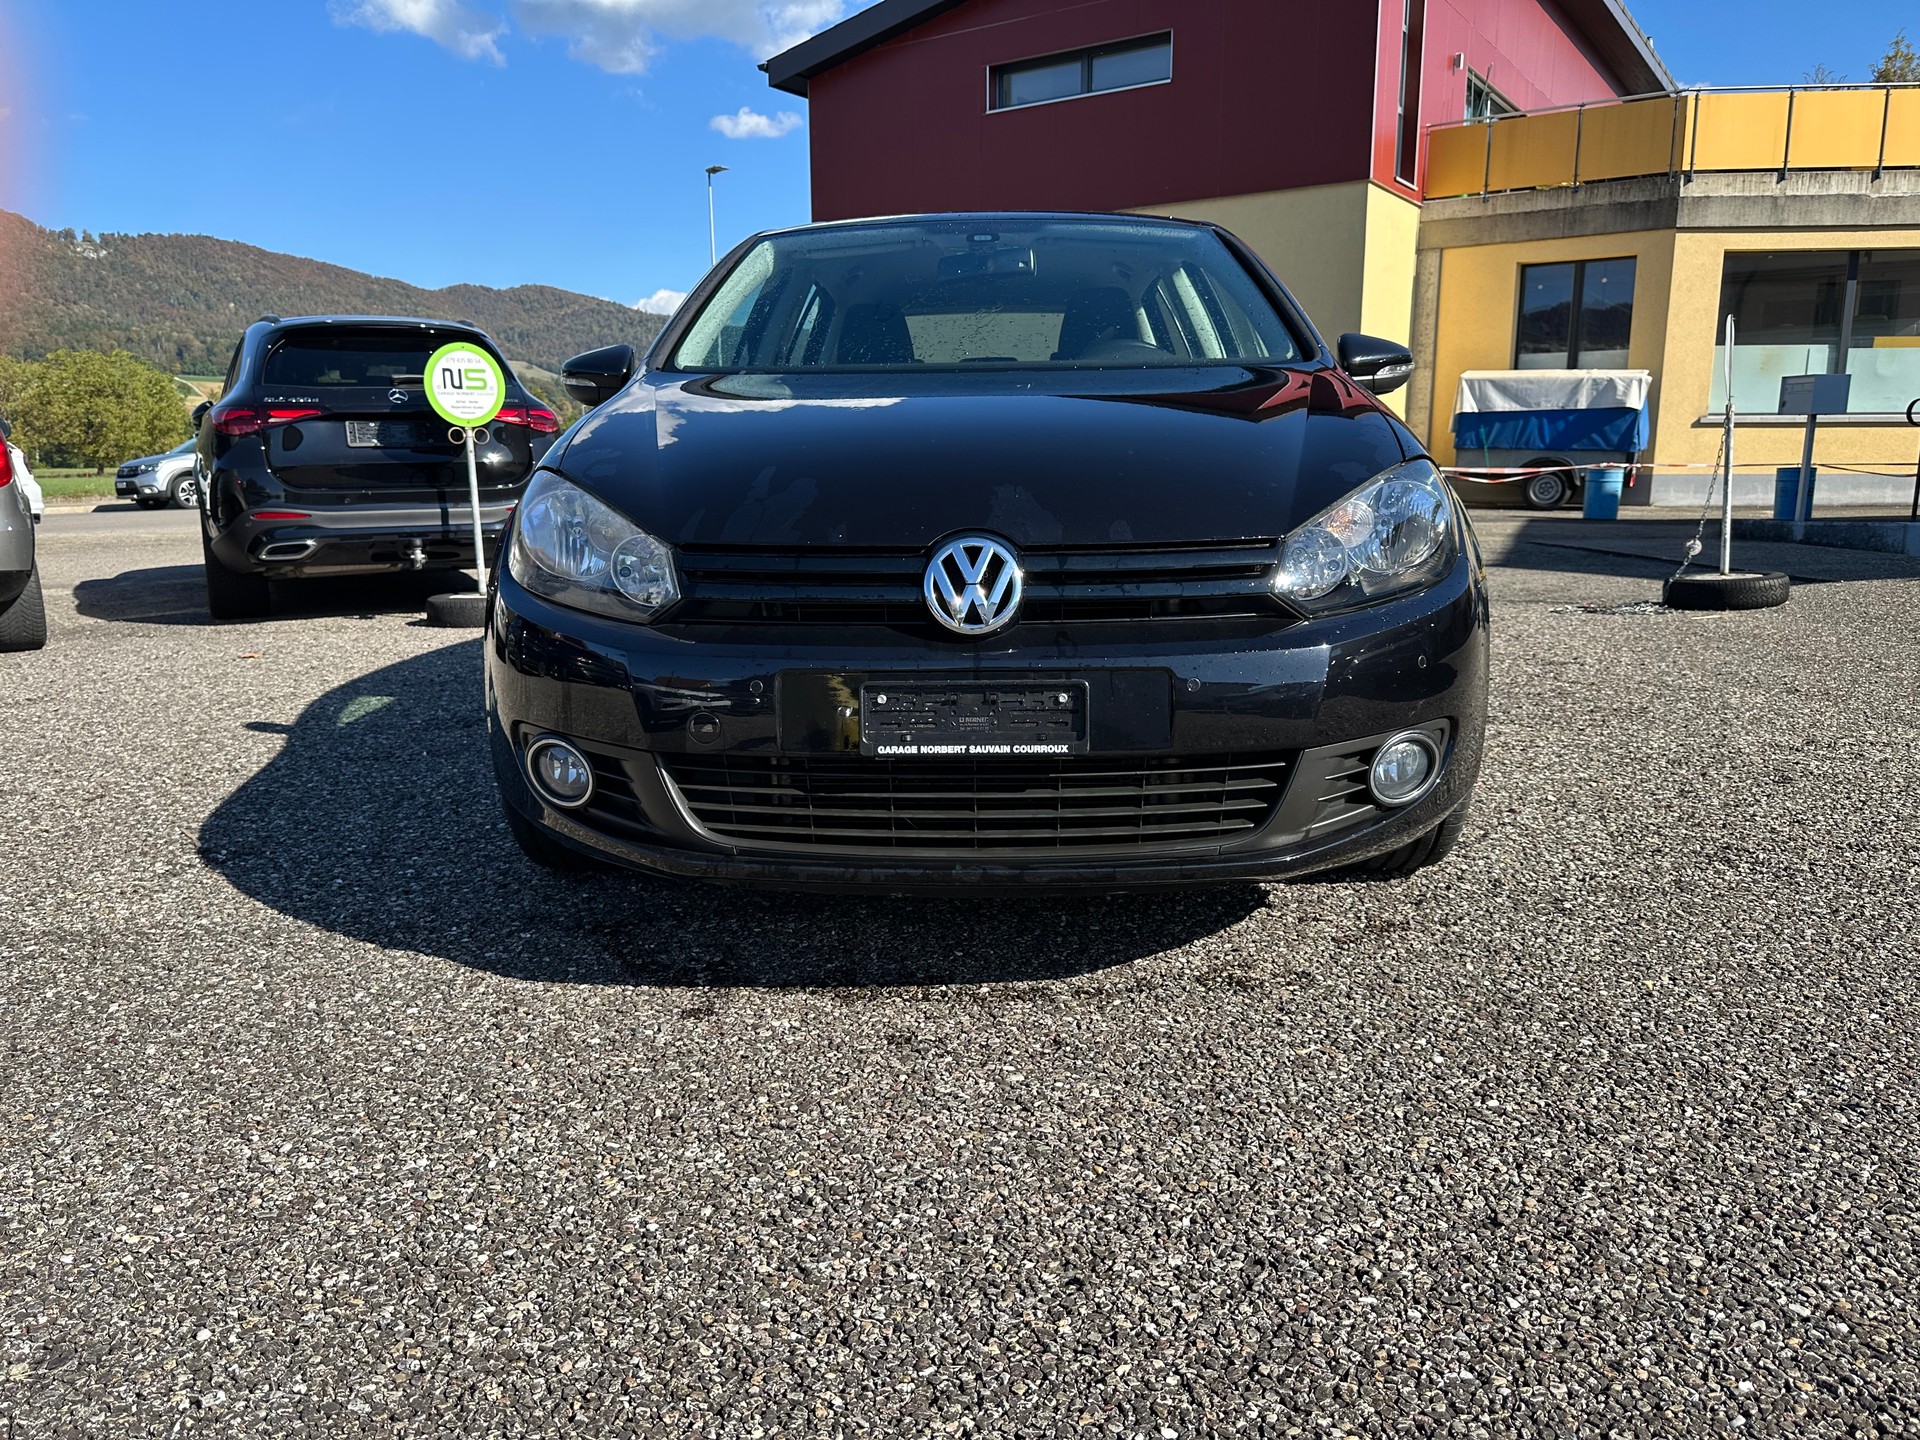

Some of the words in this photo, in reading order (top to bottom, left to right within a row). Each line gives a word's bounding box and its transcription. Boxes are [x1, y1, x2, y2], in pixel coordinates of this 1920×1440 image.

[442, 367, 487, 390] NS
[877, 745, 918, 755] GARAGE
[920, 745, 967, 755] NORBERT
[968, 745, 1011, 754] SAUVAIN
[1012, 744, 1069, 754] COURROUX
